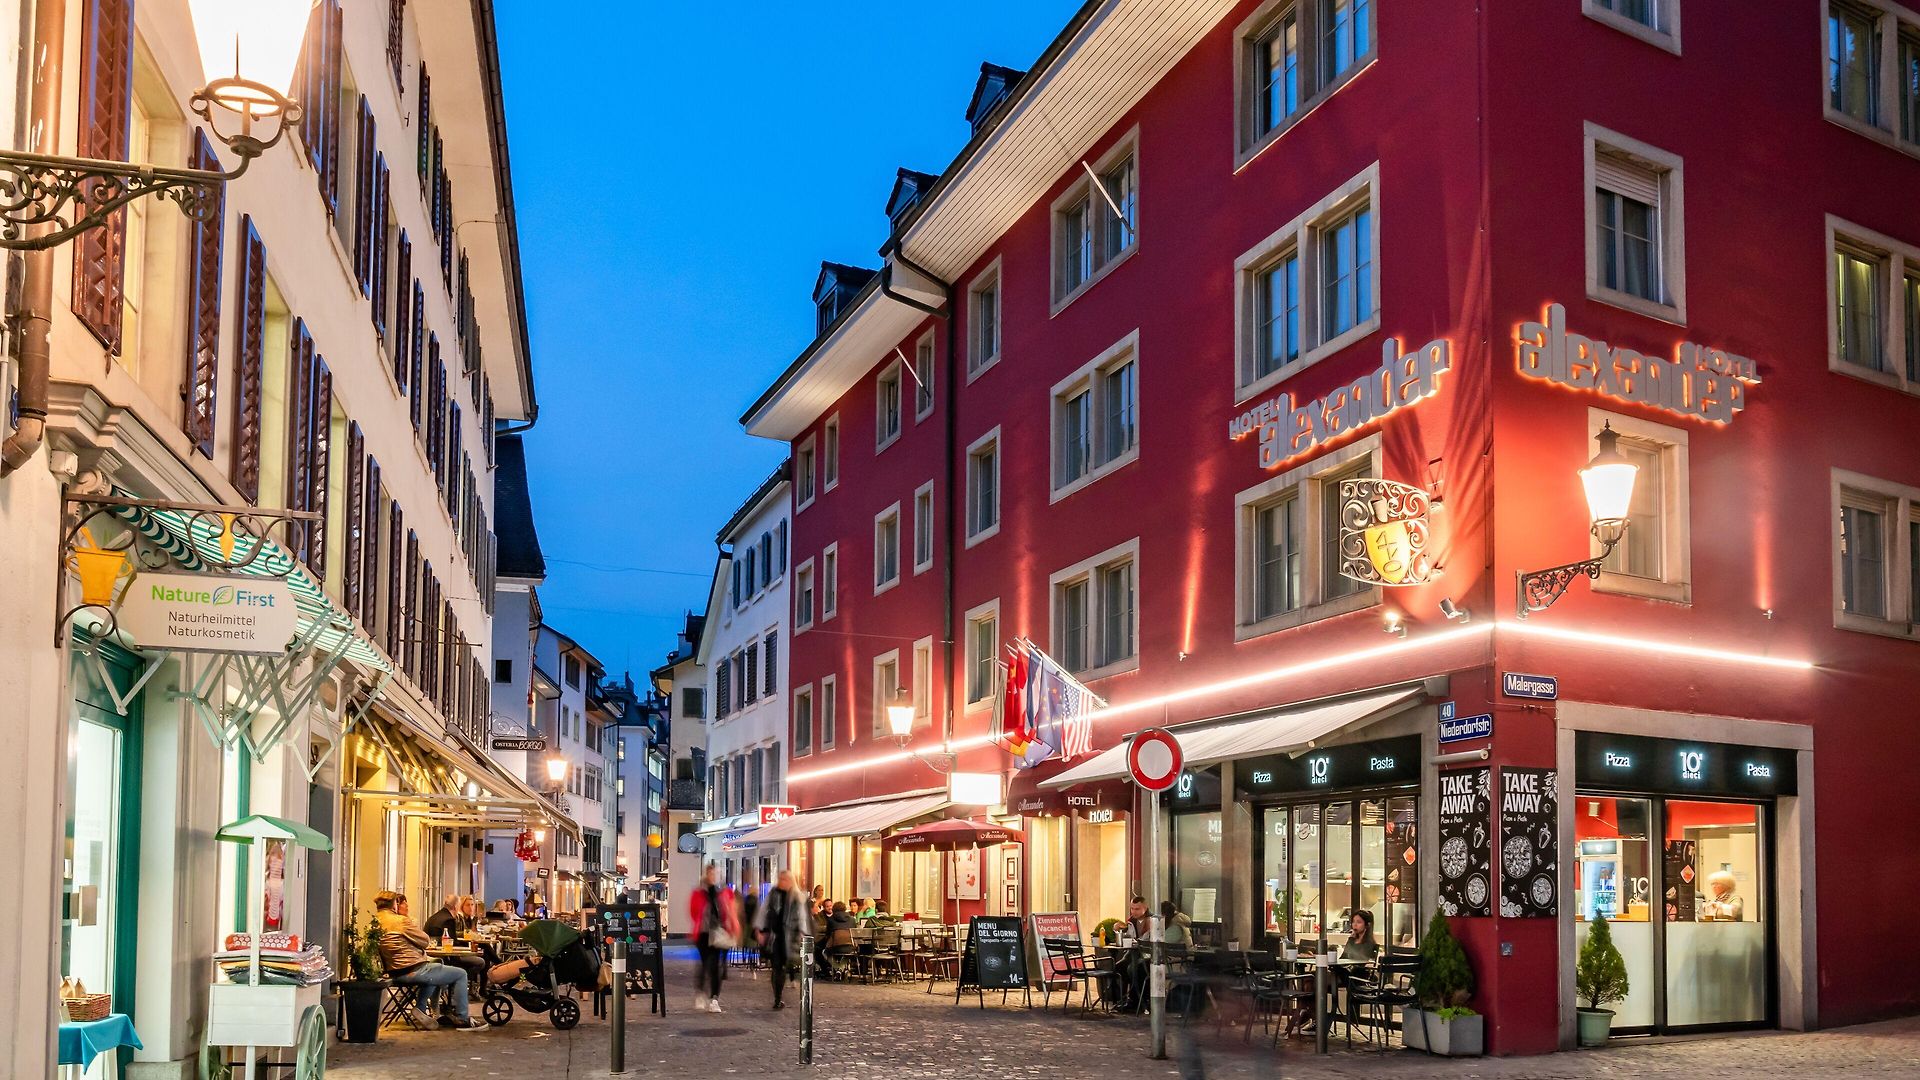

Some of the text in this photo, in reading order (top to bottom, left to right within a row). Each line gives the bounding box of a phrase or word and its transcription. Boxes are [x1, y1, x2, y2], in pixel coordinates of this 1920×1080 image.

[1519, 303, 1744, 424] alexander
[1259, 337, 1450, 468] alexander
[1229, 398, 1281, 440] HOTEL
[152, 585, 275, 607] Nature First
[168, 611, 256, 626] Naturheilmittel
[168, 625, 255, 640] Naturkosmetik
[1507, 675, 1554, 695] Malergasse
[1442, 705, 1451, 717] 40
[1440, 718, 1489, 738] Niederdorfstr.
[518, 740, 542, 750] BORGO
[1370, 757, 1395, 771] Pasta
[1605, 752, 1631, 767] Pizza
[1682, 770, 1701, 779] dieci
[1746, 763, 1771, 777] Pasta
[1253, 772, 1271, 783] Pizza
[1311, 775, 1327, 784] dieci
[1503, 772, 1539, 794] TAKE
[1441, 775, 1473, 795] TAKE
[1067, 796, 1096, 806] HOTEL
[1440, 794, 1476, 815] AWAY
[1502, 793, 1542, 813] AWAY
[1089, 809, 1113, 823] Hotel
[977, 922, 997, 930] MENU
[1064, 915, 1077, 924] frei
[992, 930, 1018, 938] GIORNO
[1038, 924, 1072, 932] Vacancies
